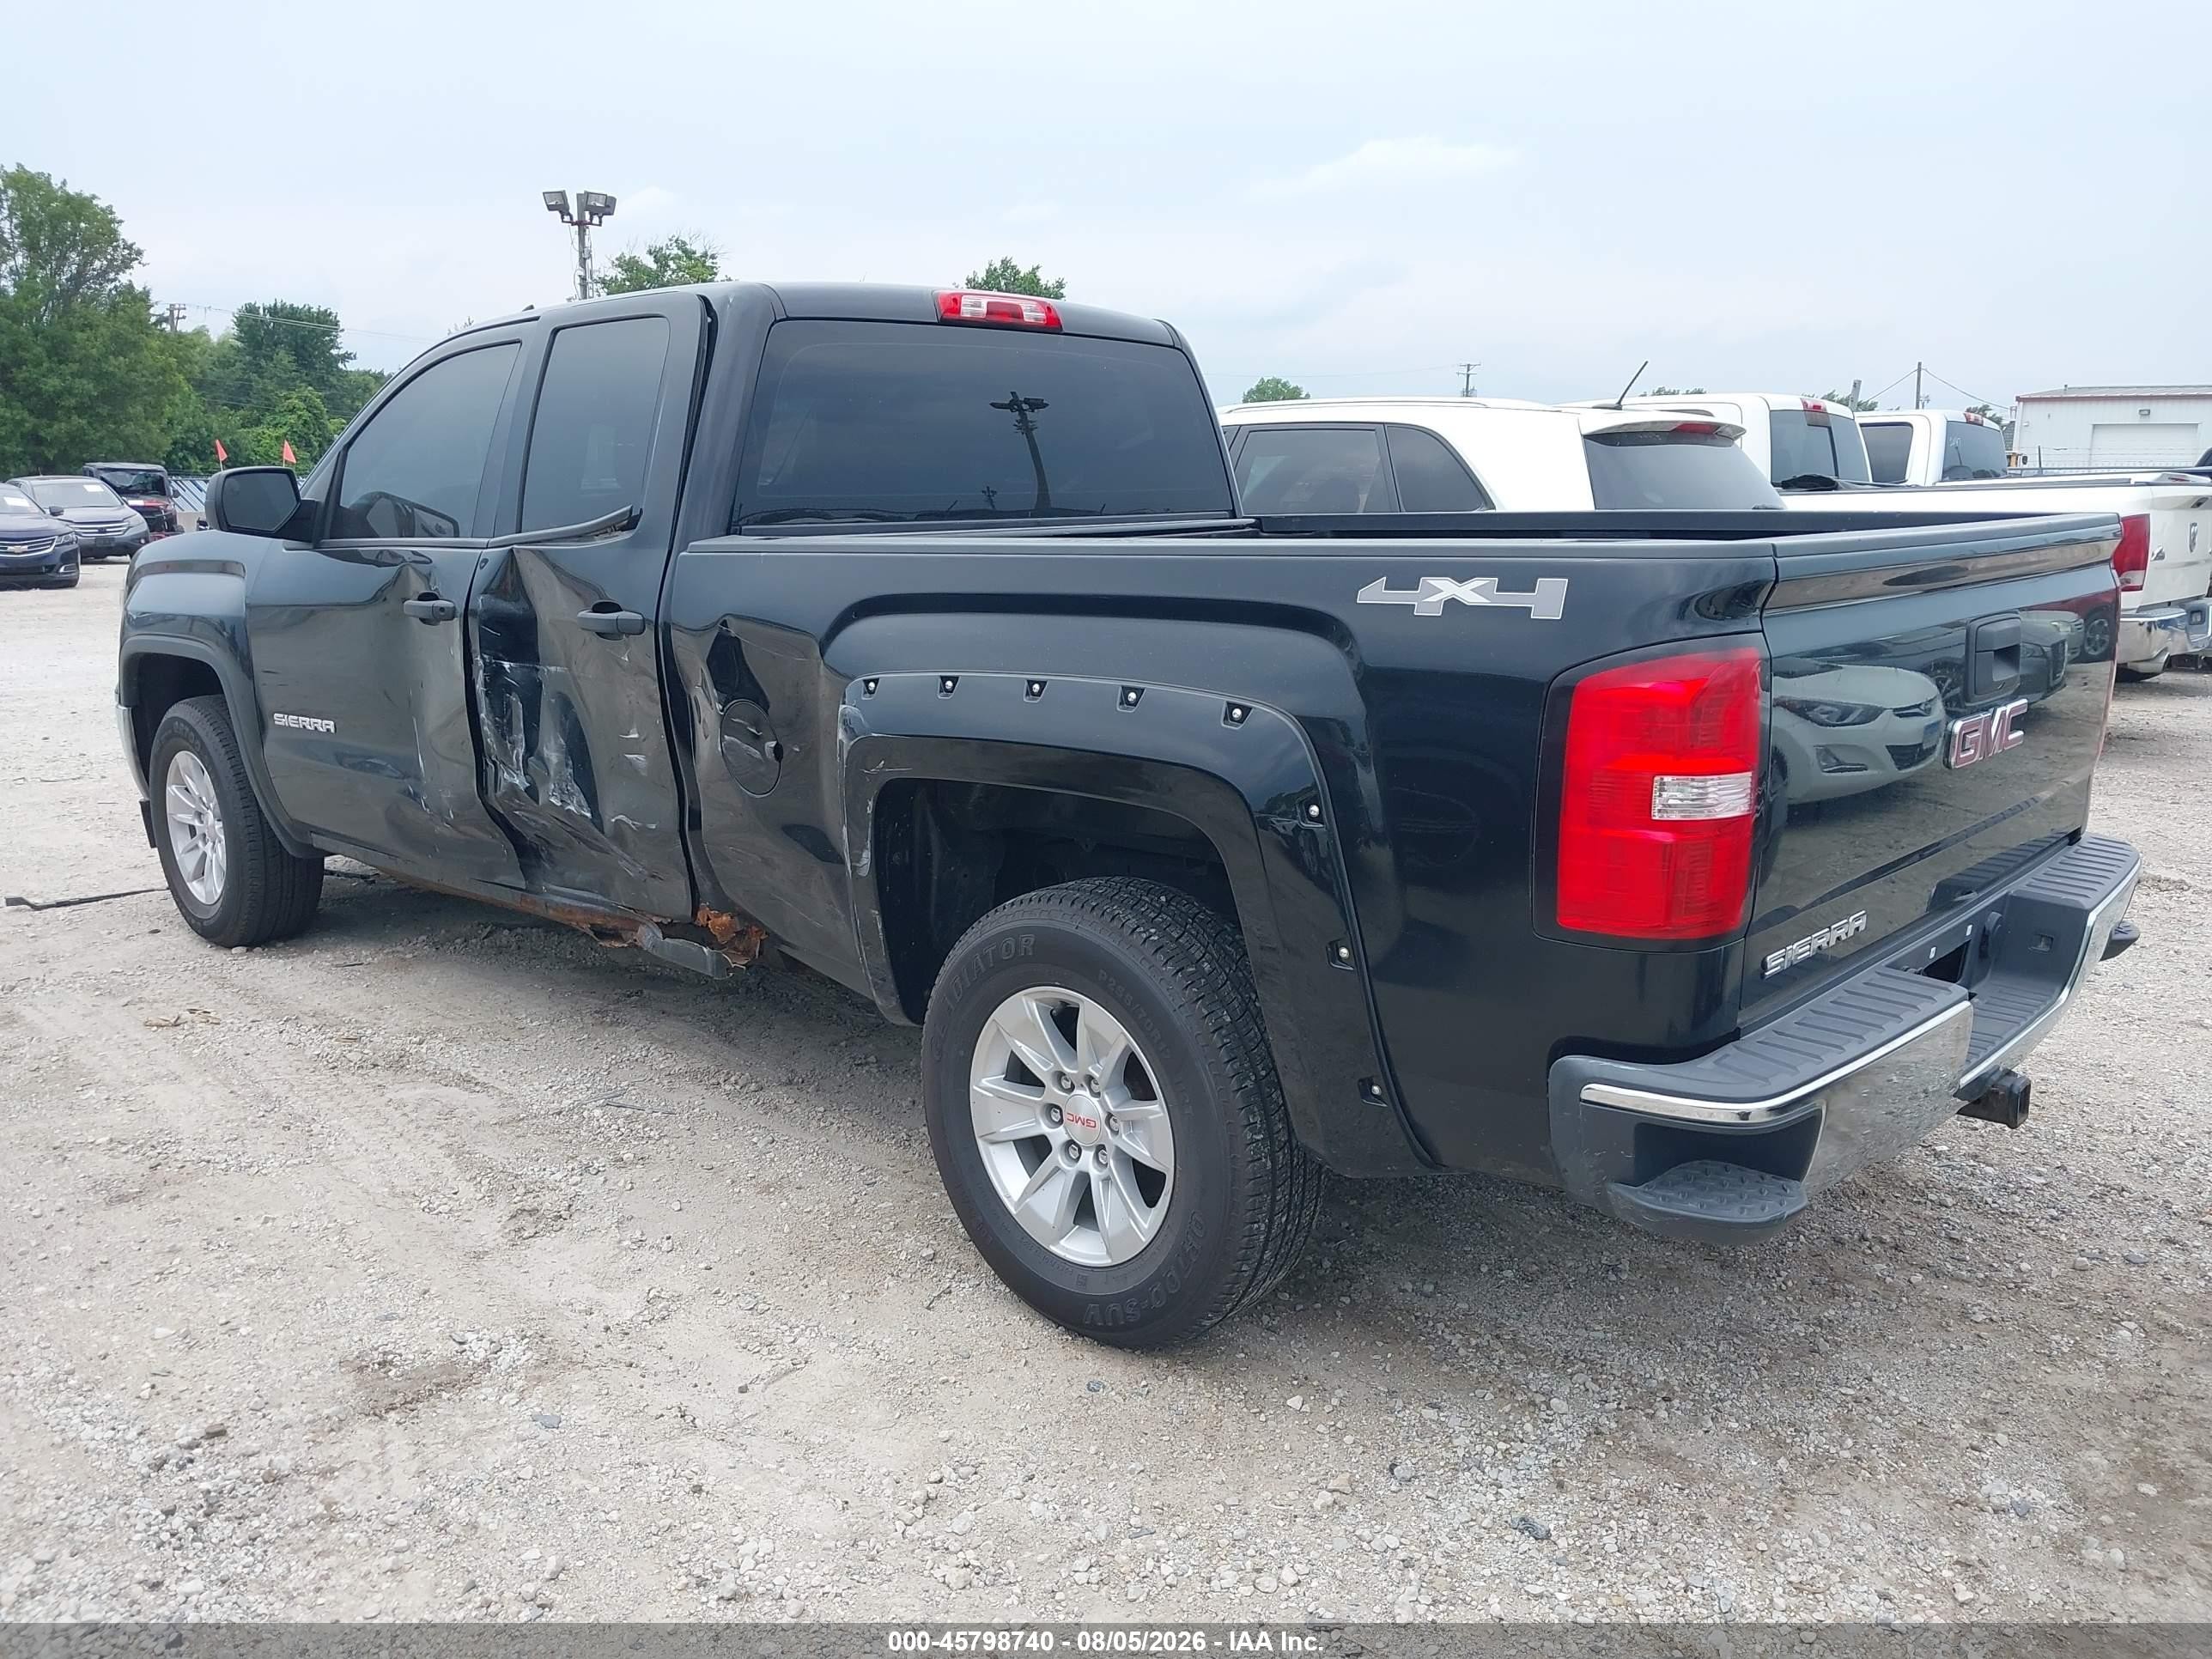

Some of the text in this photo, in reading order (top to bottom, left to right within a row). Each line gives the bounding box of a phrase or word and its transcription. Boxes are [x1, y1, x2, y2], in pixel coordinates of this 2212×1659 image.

[273, 713, 336, 733] SIERRA
[1950, 698, 2028, 769] GMC
[1764, 909, 1867, 979] SIERRA
[1066, 1112, 1097, 1129] GMC
